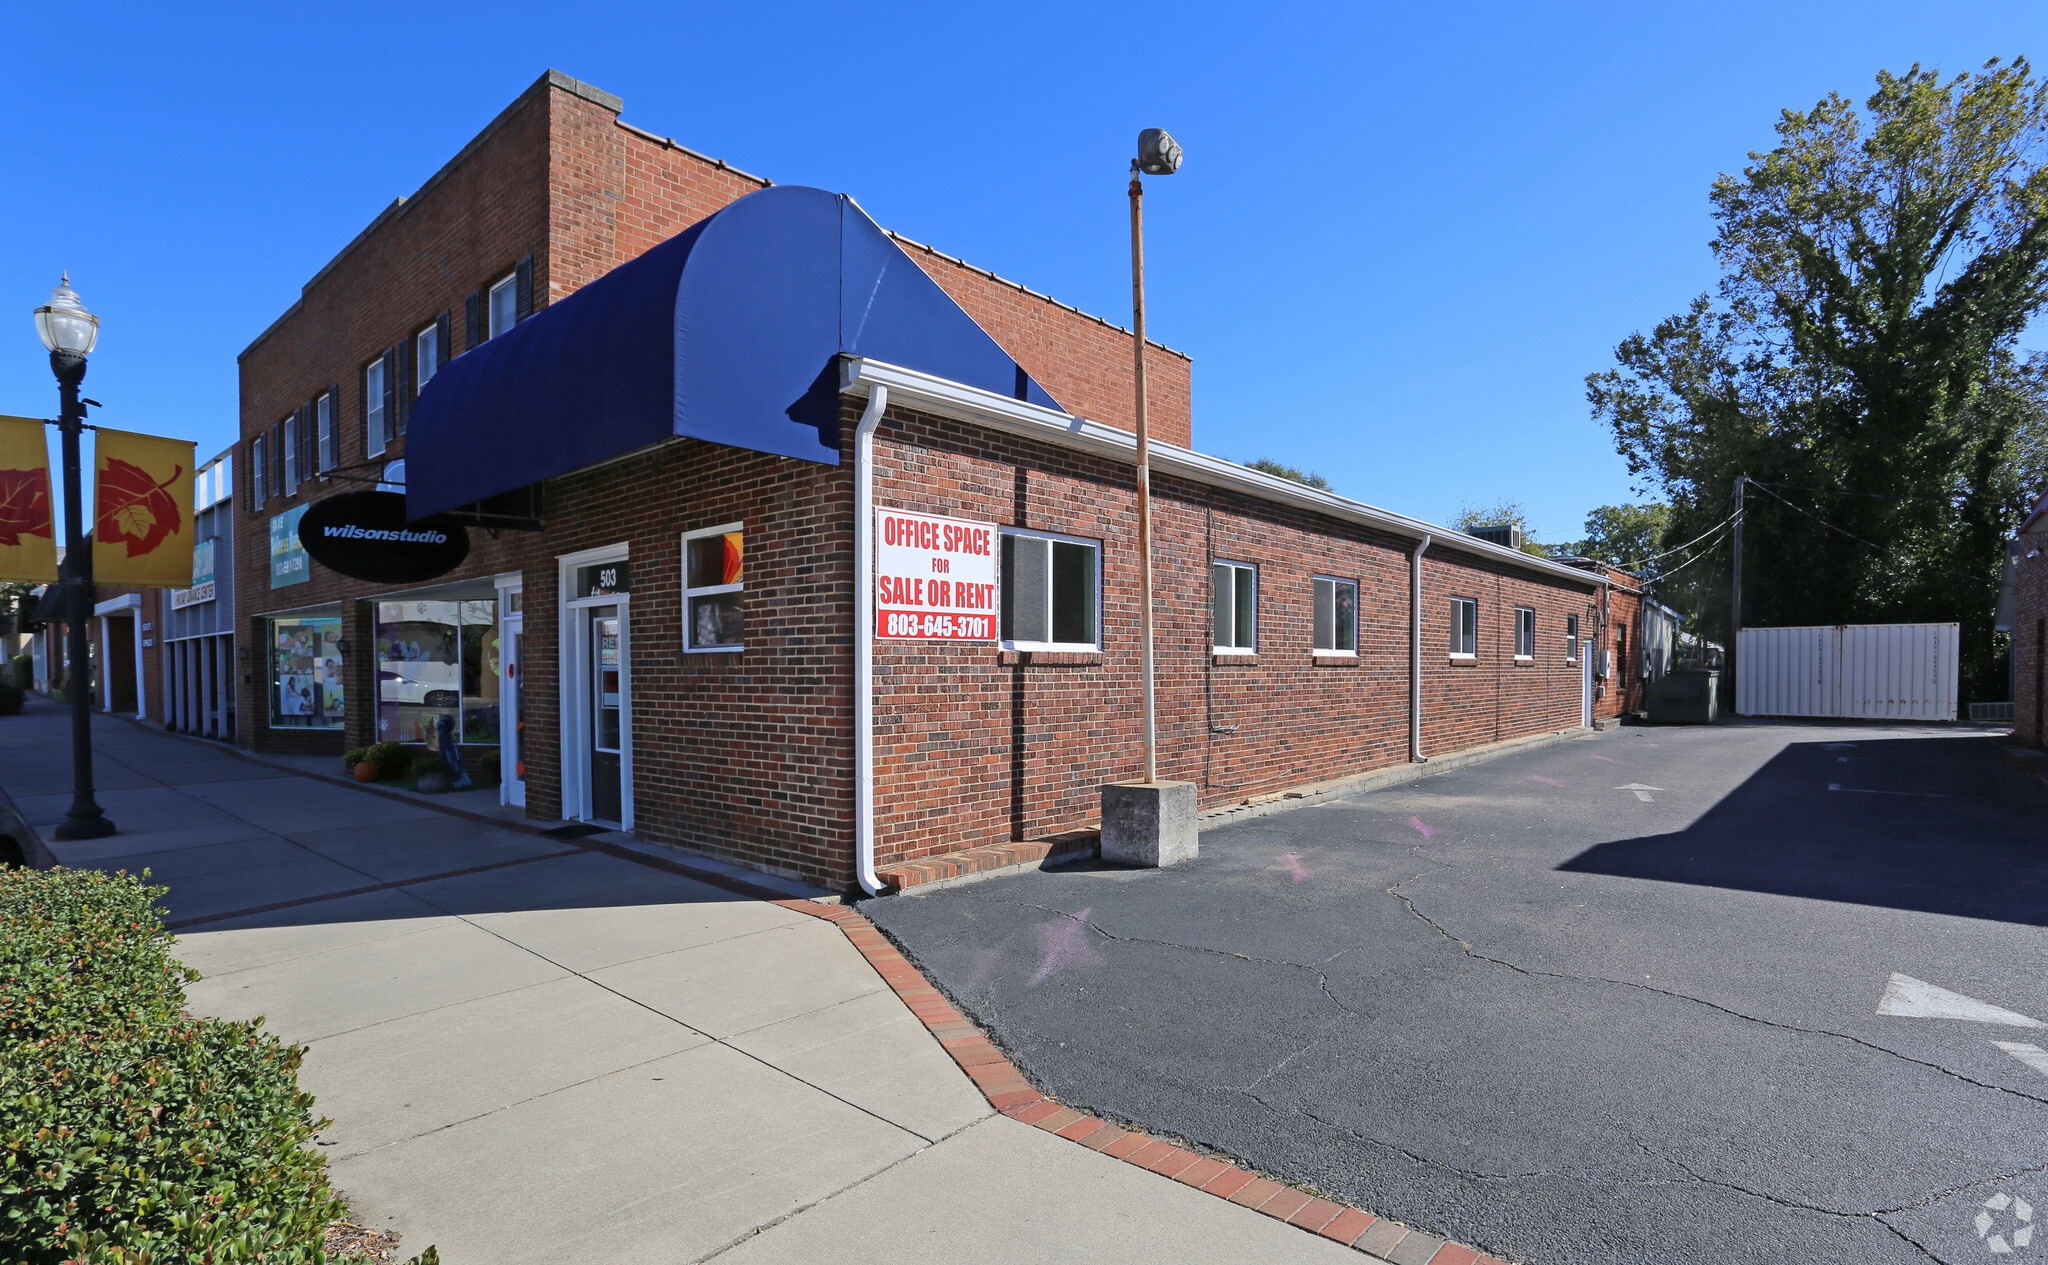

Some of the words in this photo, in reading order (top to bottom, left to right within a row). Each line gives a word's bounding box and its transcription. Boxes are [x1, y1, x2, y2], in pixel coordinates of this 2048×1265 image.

[324, 524, 447, 544] wilsonstudio
[884, 516, 940, 550] OFFICE
[943, 524, 990, 556] SPACE
[931, 557, 950, 574] FOR
[600, 568, 617, 588] 503
[879, 575, 923, 606] SALE
[927, 579, 951, 607] OR
[955, 581, 995, 610] RENT
[887, 612, 989, 638] 803-645-3701
